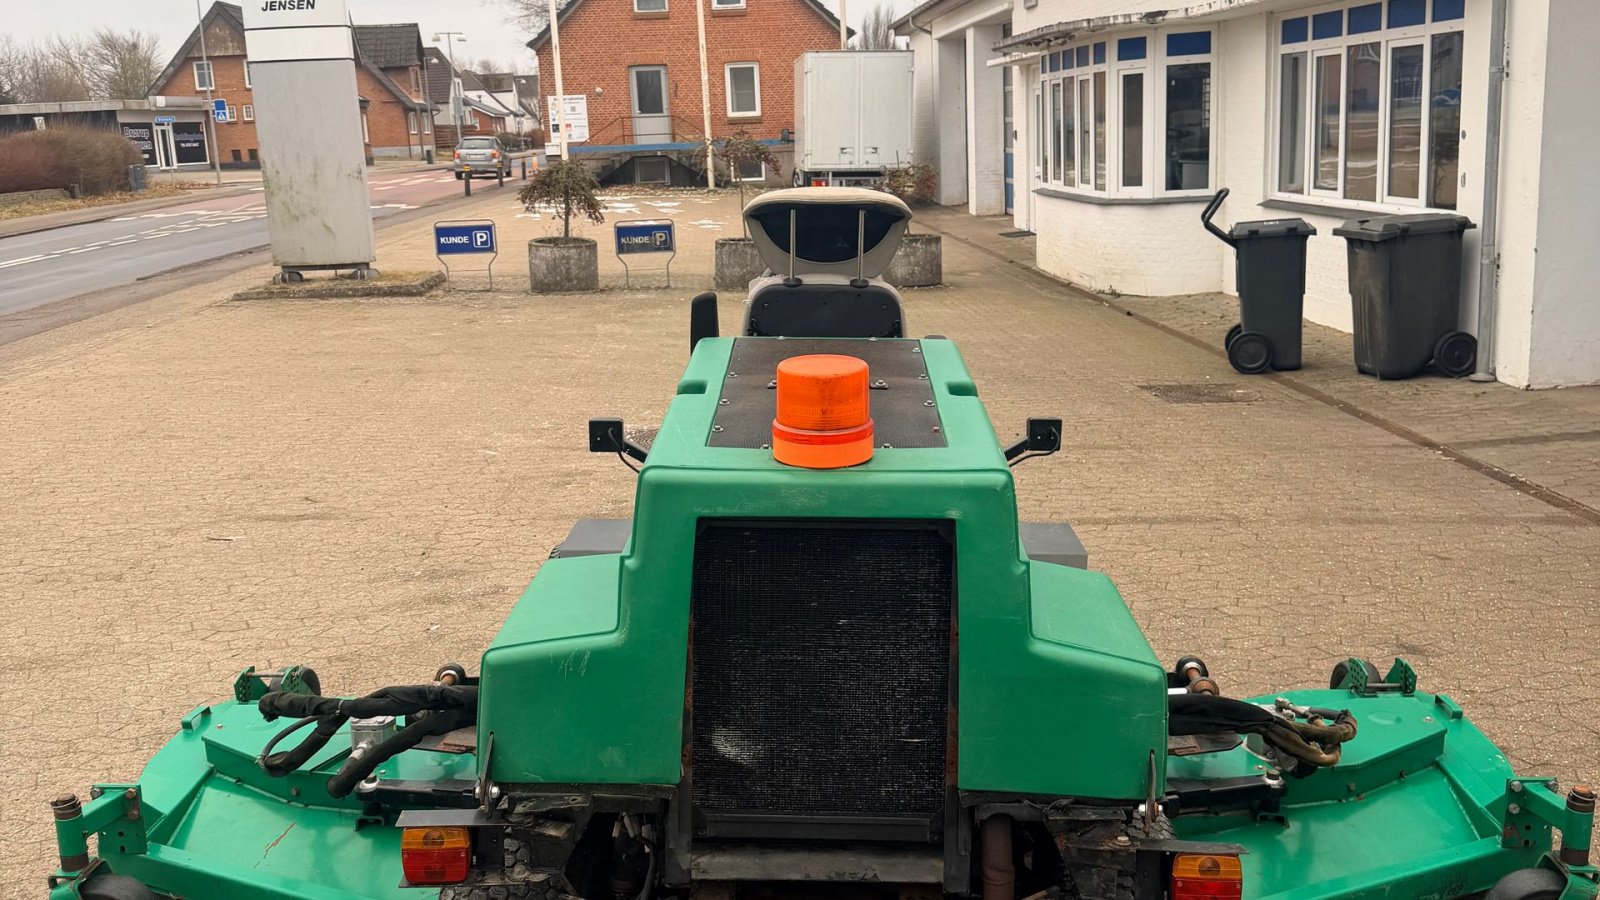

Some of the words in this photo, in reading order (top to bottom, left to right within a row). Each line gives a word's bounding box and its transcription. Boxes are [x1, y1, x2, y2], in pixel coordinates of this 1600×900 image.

[261, 0, 316, 11] JENSEN
[440, 236, 470, 244] KUNDE
[476, 232, 487, 246] P
[620, 236, 650, 244] KUNDE
[655, 232, 666, 246] P
